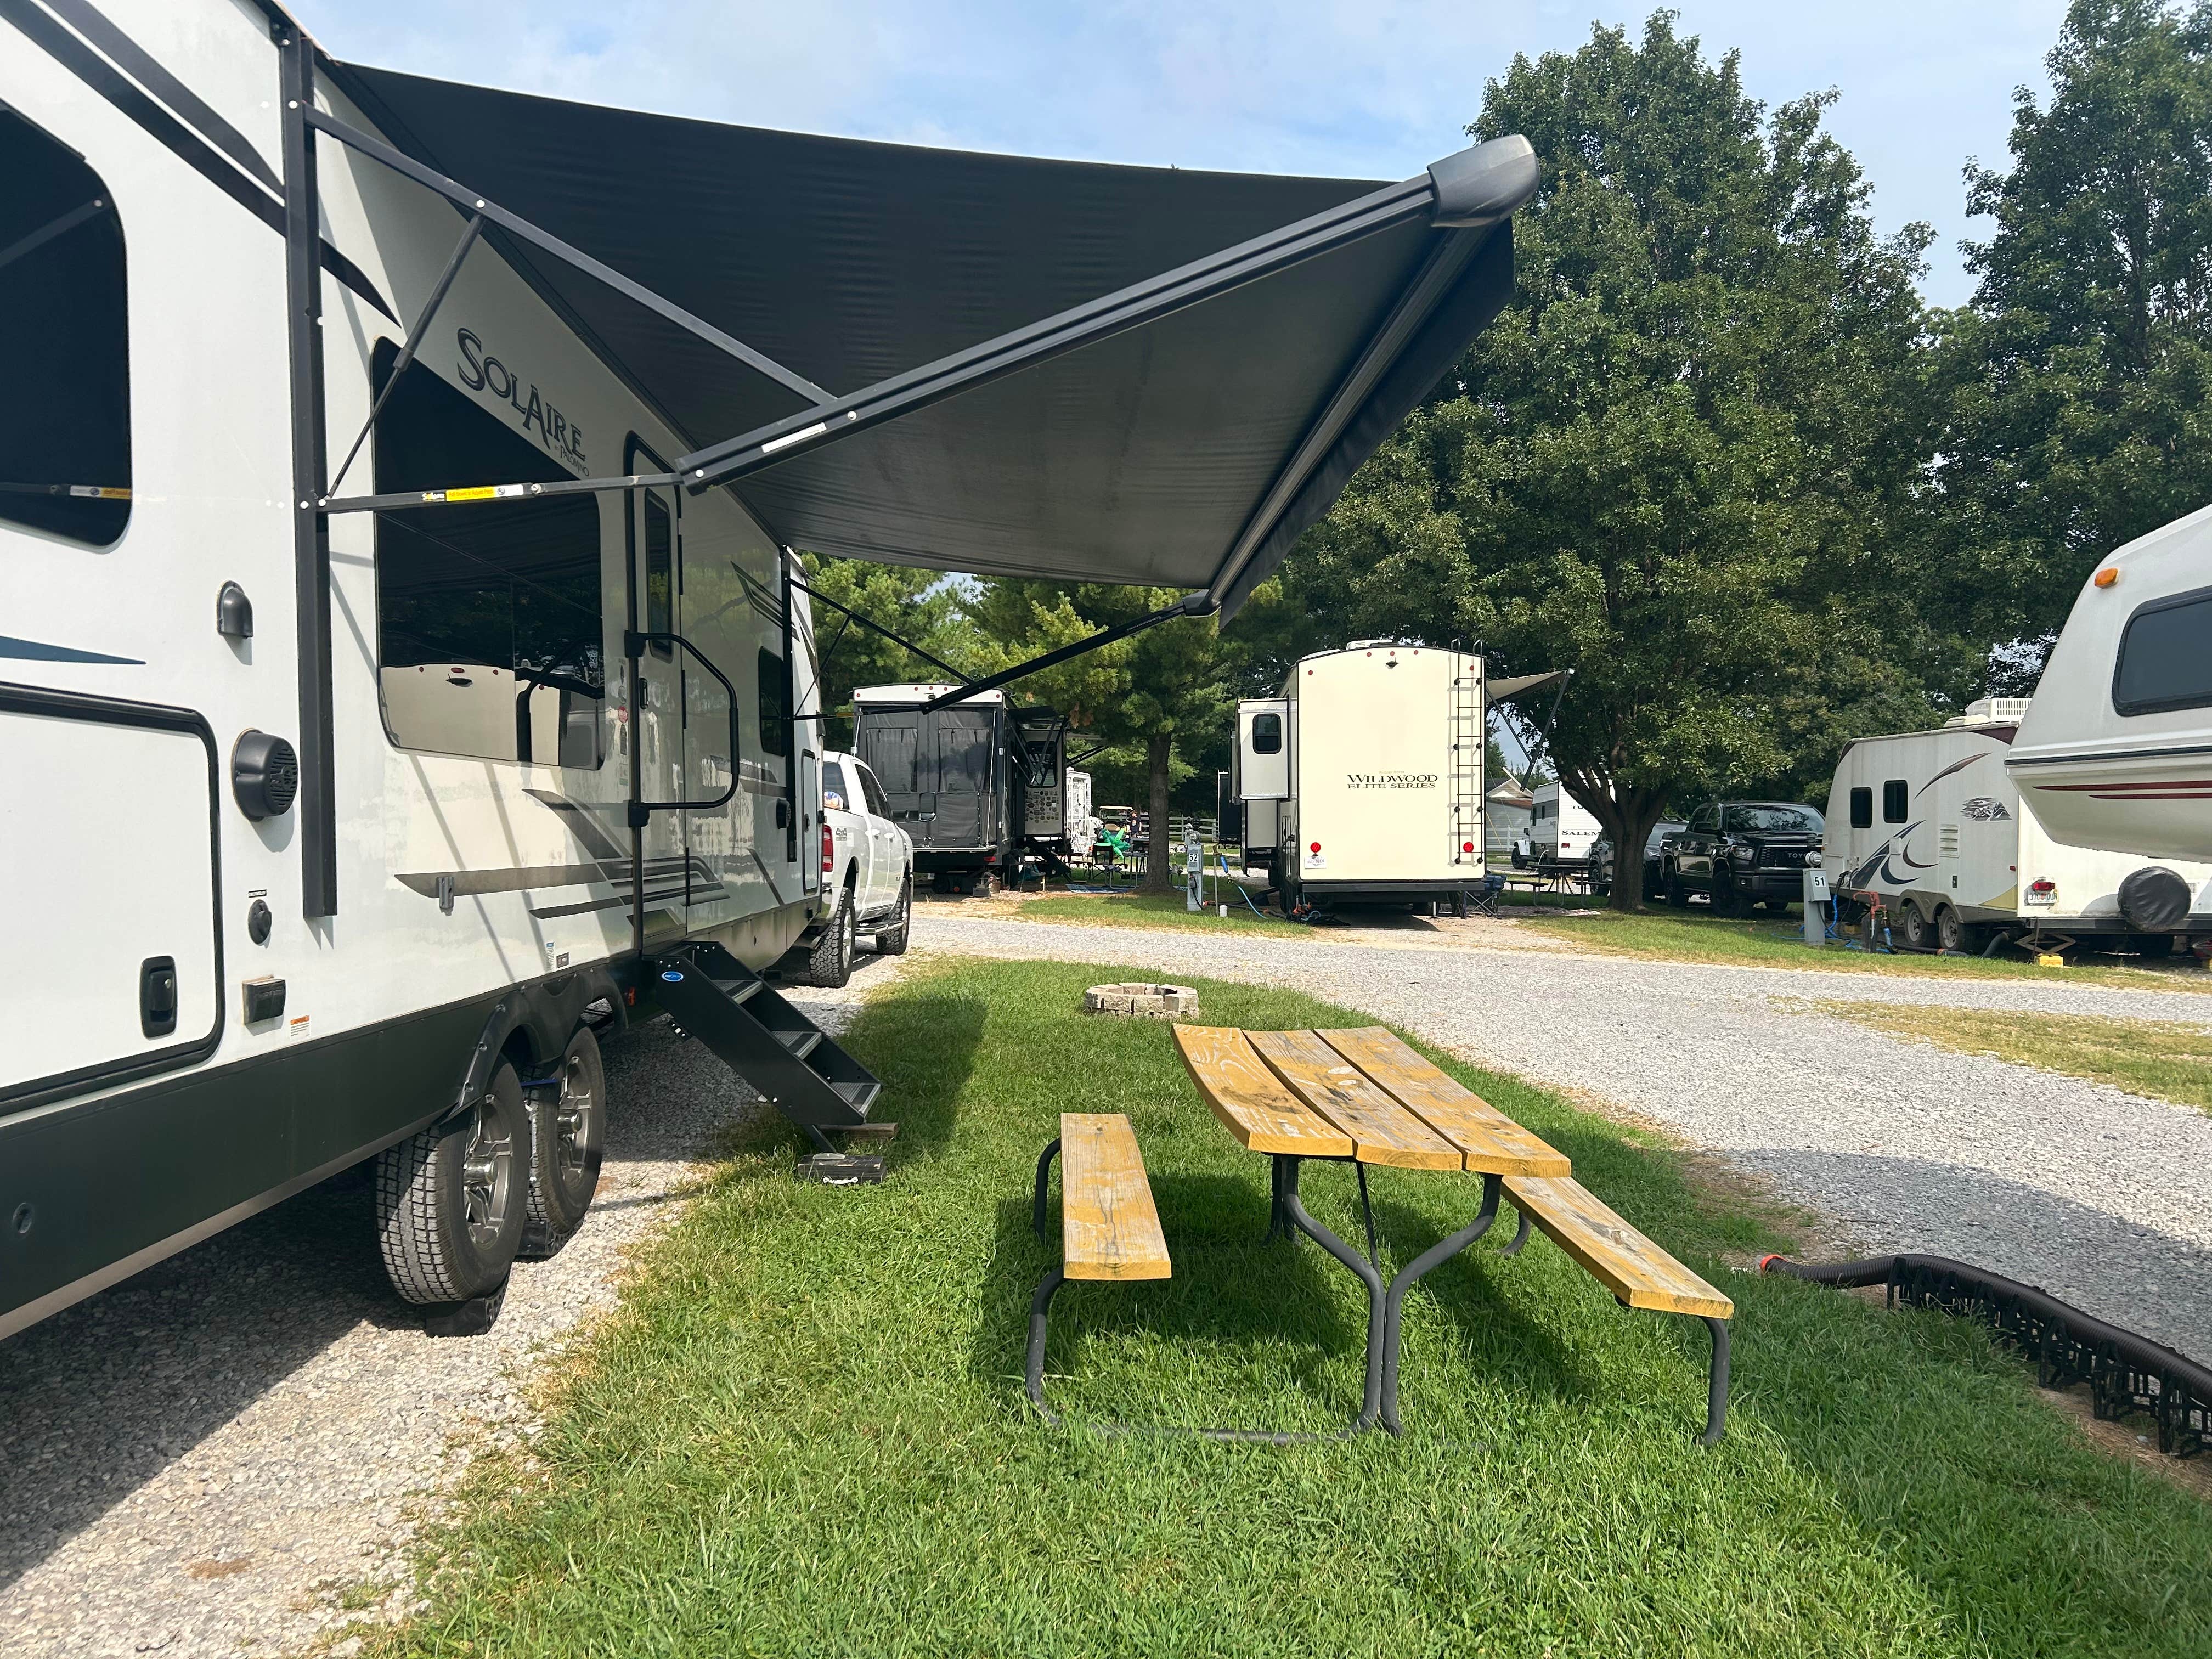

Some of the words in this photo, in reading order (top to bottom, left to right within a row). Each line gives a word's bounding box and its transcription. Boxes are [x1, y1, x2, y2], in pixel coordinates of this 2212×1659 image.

[1347, 775, 1438, 783] WILDWOOD
[1189, 853, 1198, 861] 52
[1814, 877, 1825, 887] 51
